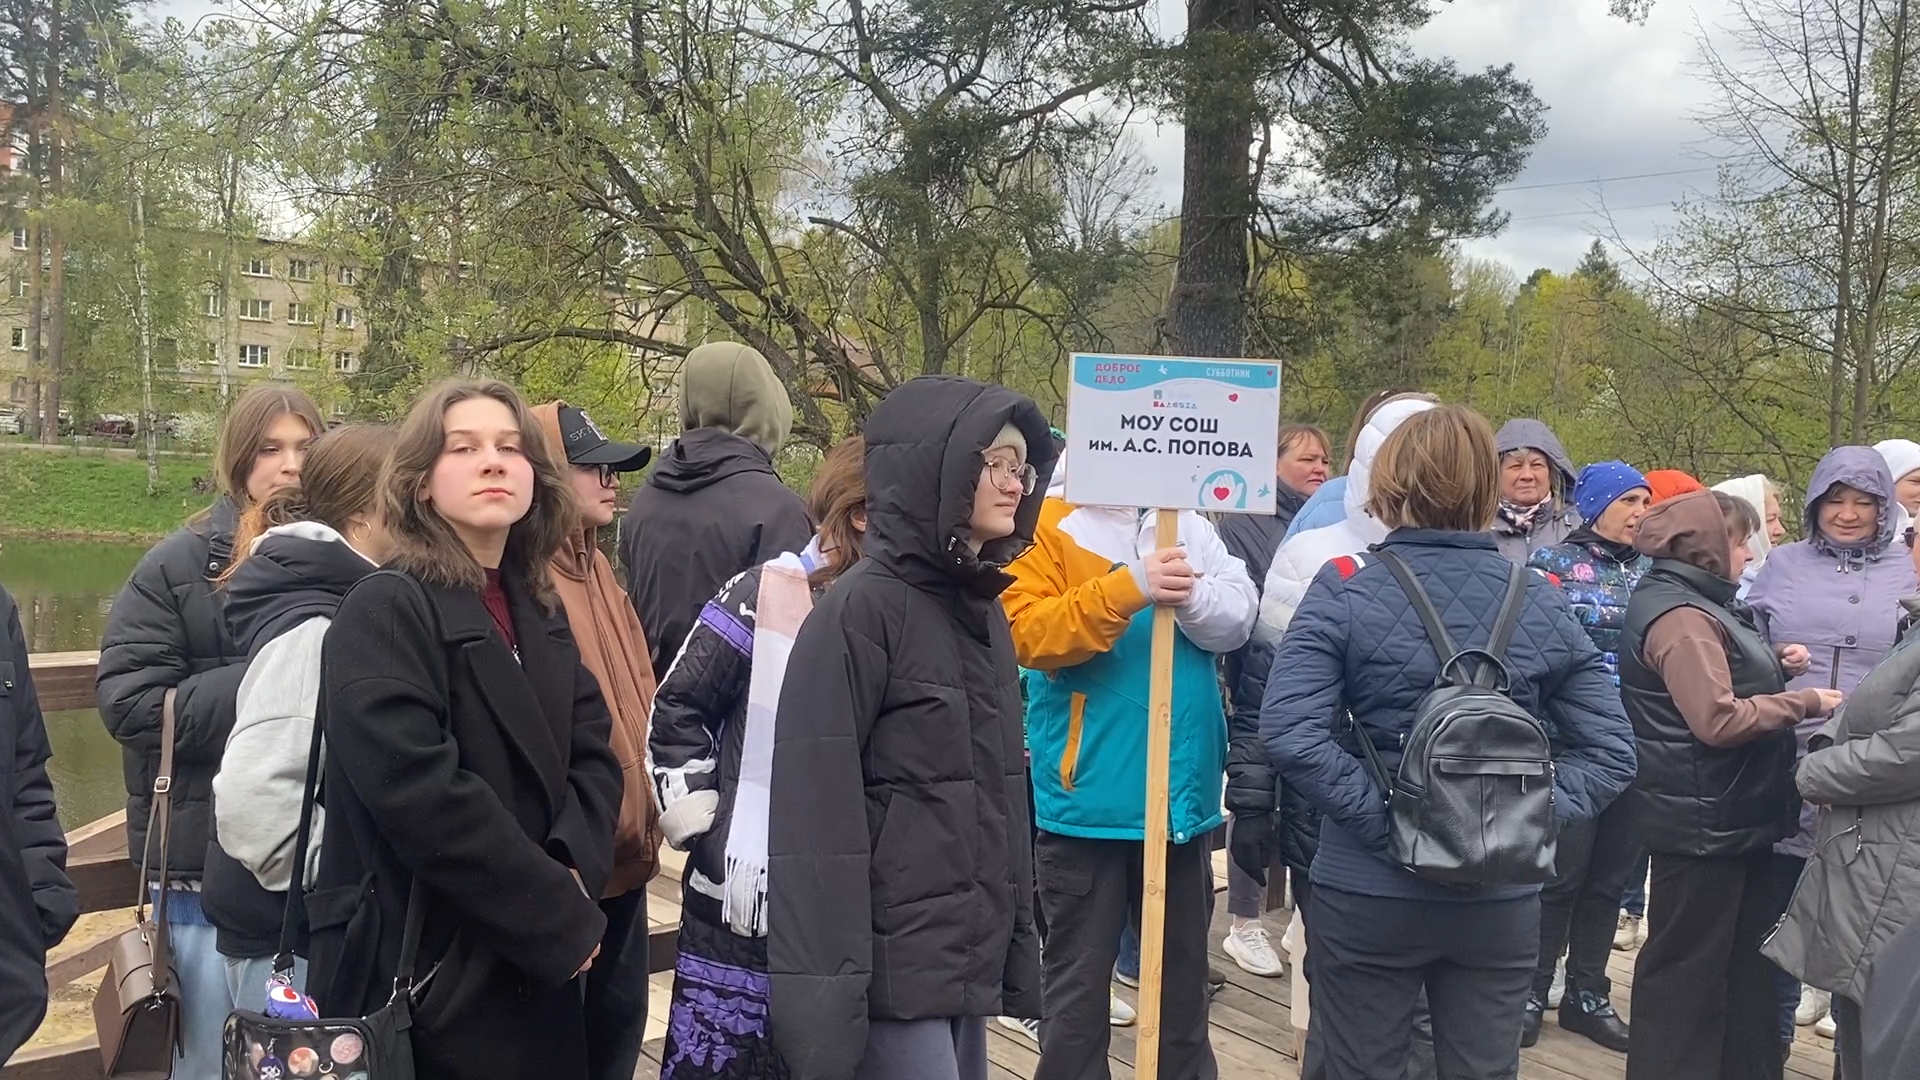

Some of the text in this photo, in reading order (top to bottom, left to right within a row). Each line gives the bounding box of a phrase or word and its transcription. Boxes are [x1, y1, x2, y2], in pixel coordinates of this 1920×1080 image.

[1094, 363, 1141, 373] ДОБРОЕ
[1206, 367, 1251, 378] СУББОТНИК
[1094, 375, 1126, 384] ДЕЛО
[1121, 414, 1218, 433] МОУ СОШ
[1089, 437, 1253, 458] им. А.С. ПОПОВА
